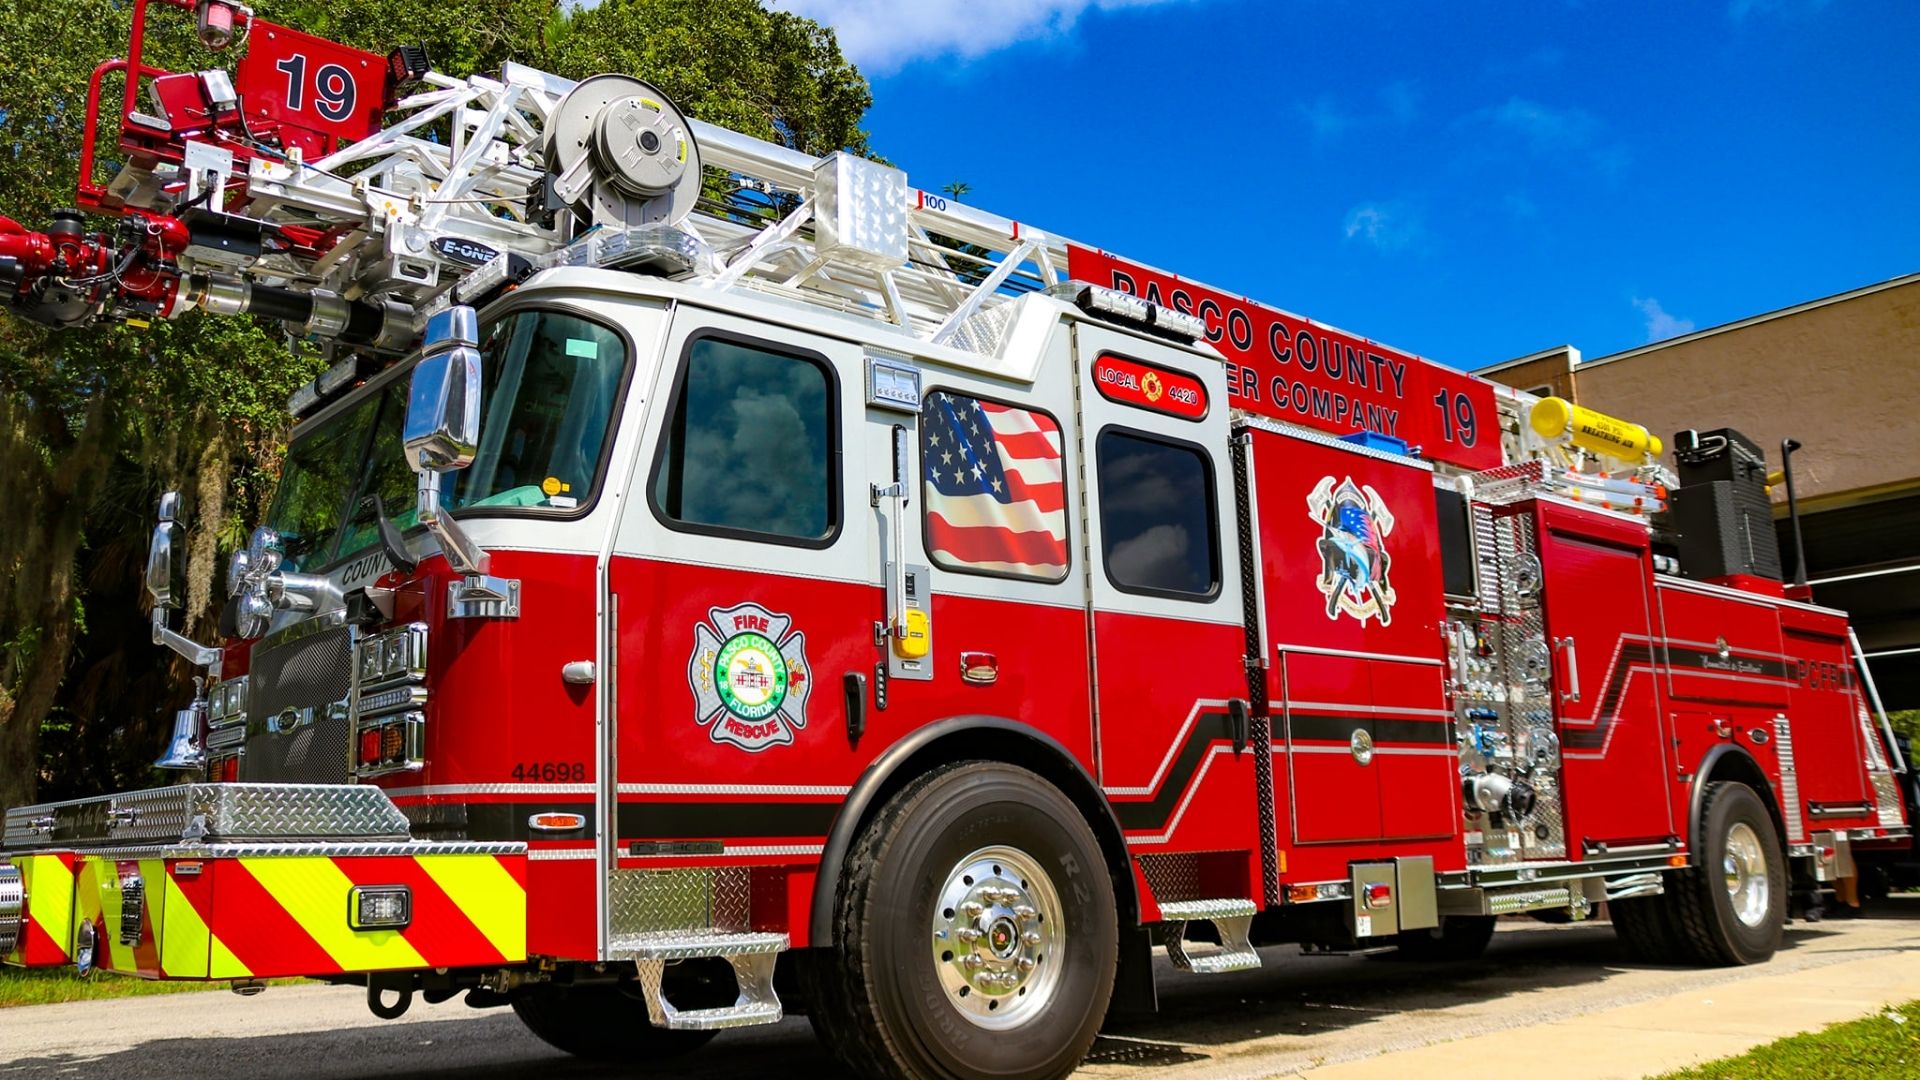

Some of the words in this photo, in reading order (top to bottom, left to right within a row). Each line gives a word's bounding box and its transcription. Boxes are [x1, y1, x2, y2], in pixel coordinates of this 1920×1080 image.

[276, 53, 357, 122] 19
[924, 195, 946, 211] 100
[443, 240, 496, 262] E-ONE
[1112, 269, 1253, 351] PASCO
[1268, 322, 1406, 398] COUNTY
[1098, 366, 1140, 391] LOCAL
[1169, 386, 1198, 406] 4420
[1271, 376, 1398, 436] COMPANY
[1433, 388, 1477, 448] 19
[733, 615, 769, 633] FIRE
[719, 637, 749, 668] PASCO
[751, 637, 785, 673] COUNTY
[729, 699, 775, 718] FLORIDA
[724, 716, 780, 739] RESCUE
[511, 762, 585, 782] 44698
